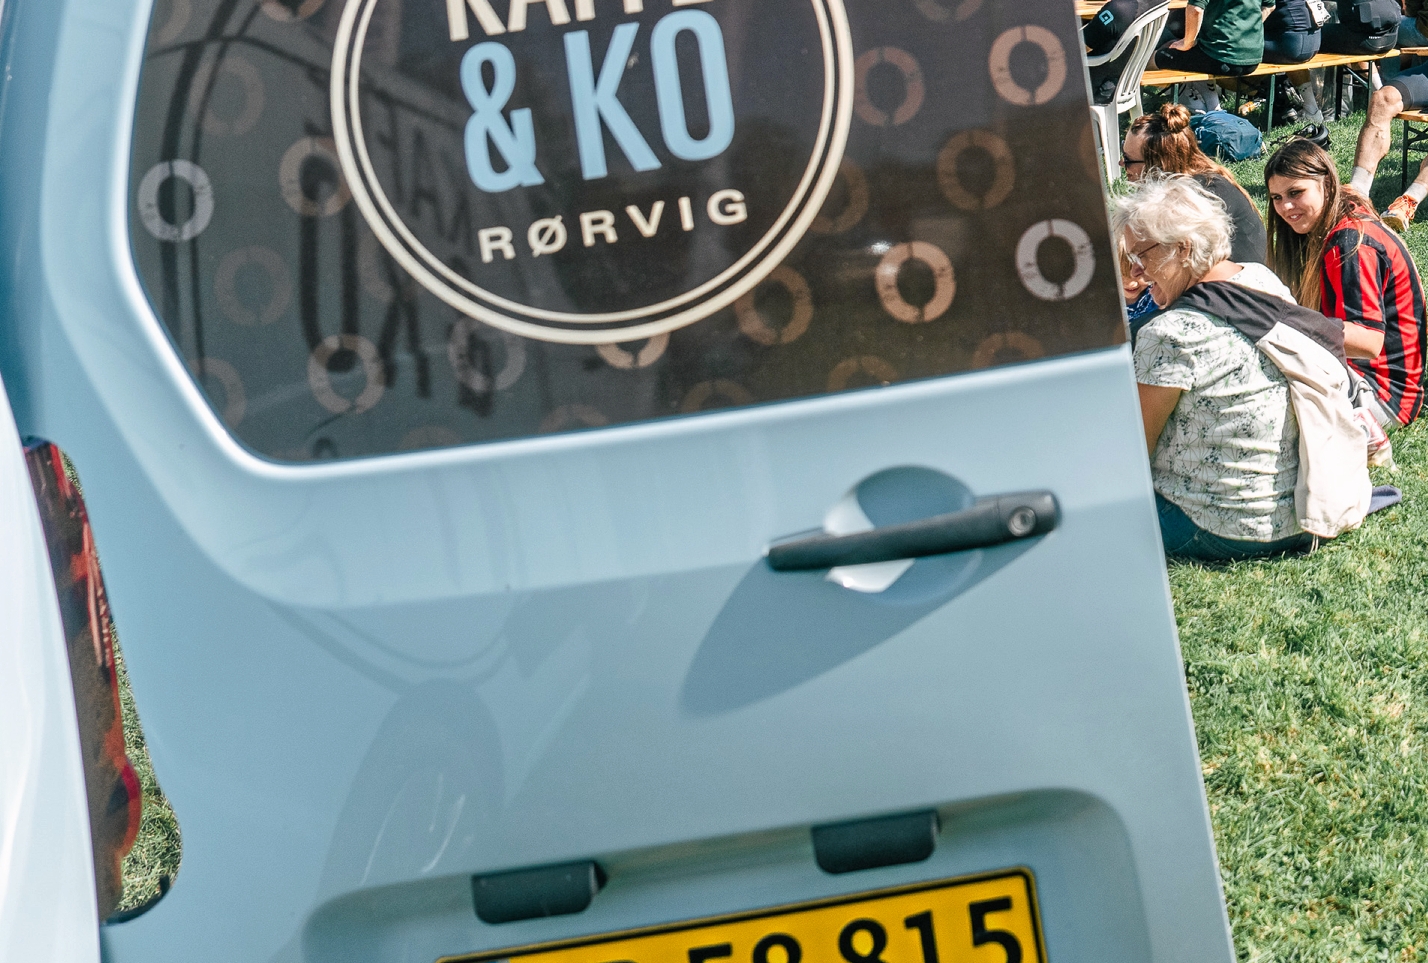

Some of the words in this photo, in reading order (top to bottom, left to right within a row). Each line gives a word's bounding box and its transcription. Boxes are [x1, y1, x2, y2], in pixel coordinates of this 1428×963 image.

[460, 41, 545, 193] &
[563, 8, 735, 180] KO
[477, 188, 748, 263] RØRVIG
